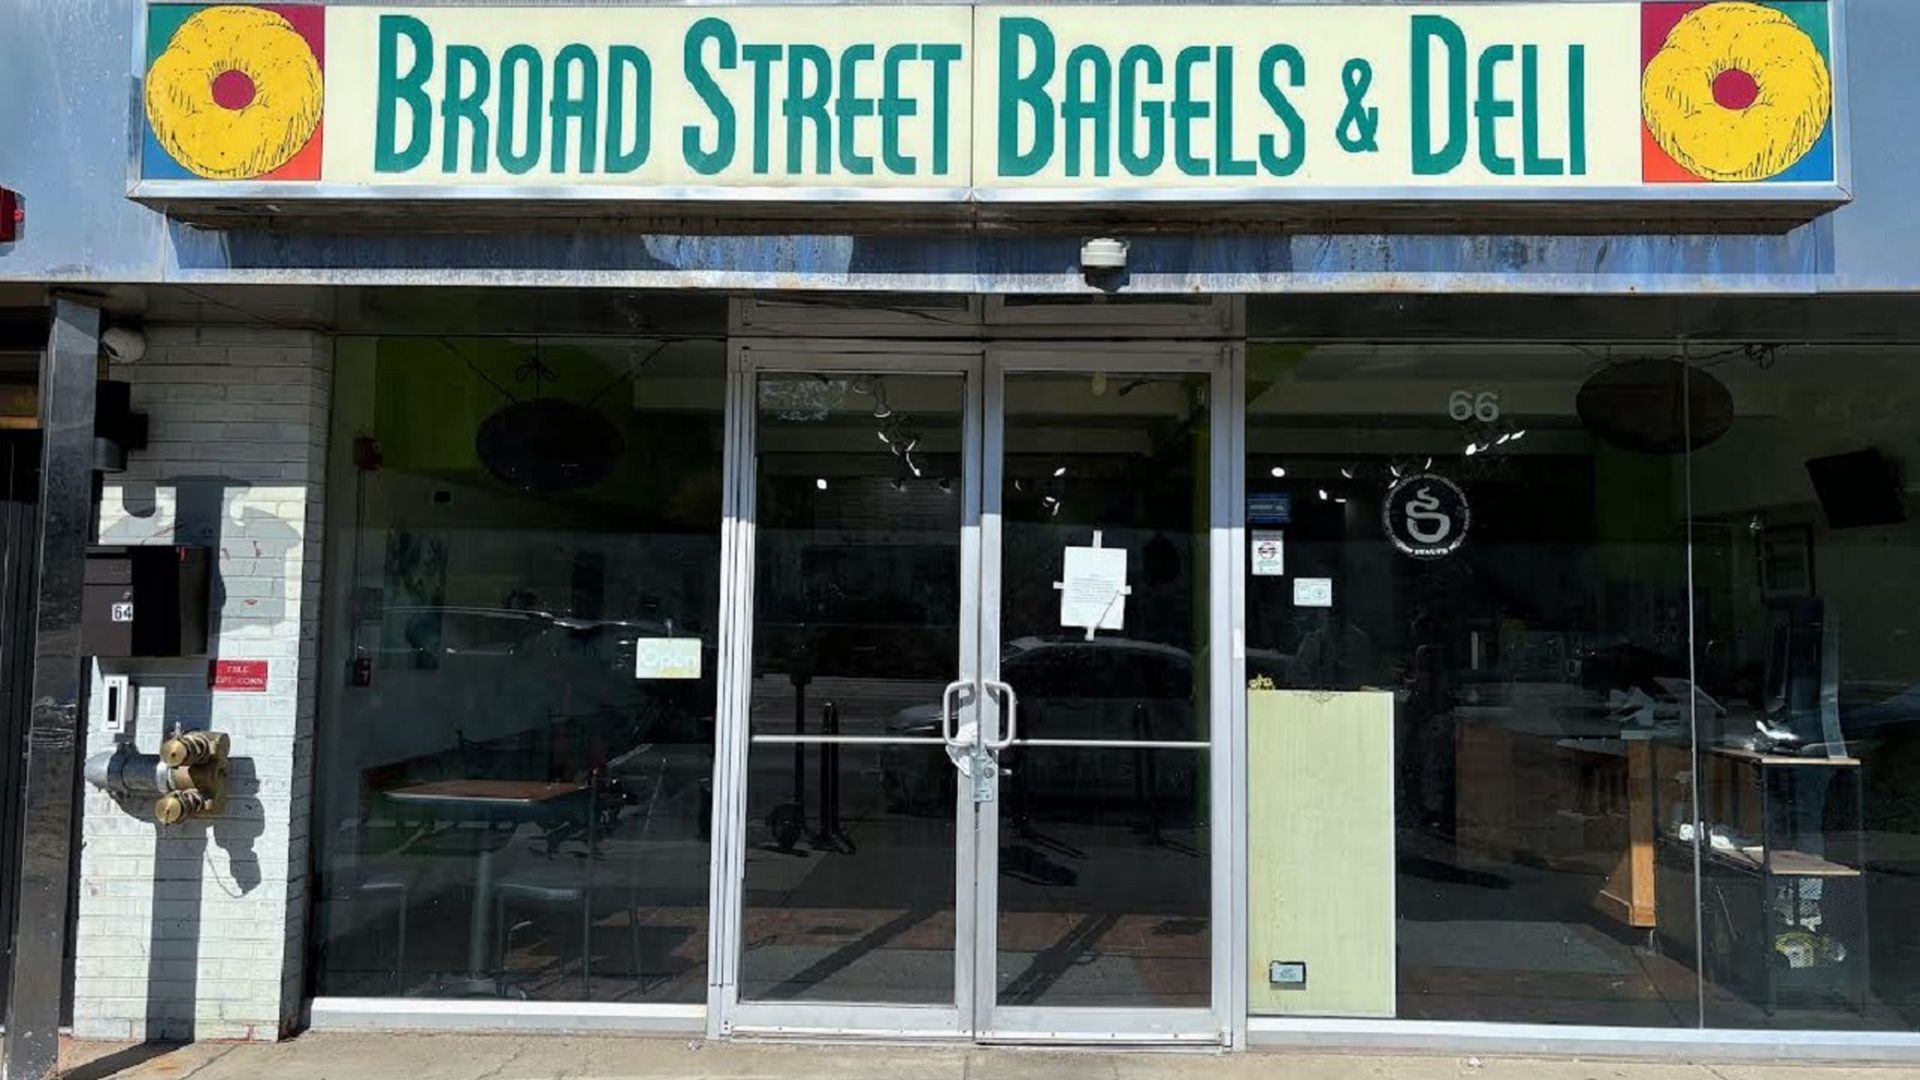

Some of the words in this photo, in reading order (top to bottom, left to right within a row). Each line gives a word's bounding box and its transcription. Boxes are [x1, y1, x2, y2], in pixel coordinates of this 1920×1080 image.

[373, 15, 653, 174] BROAD
[682, 16, 963, 177] STREET
[998, 16, 1306, 178] BAGELS
[1336, 58, 1380, 153] &
[1409, 14, 1587, 177] DELI
[1448, 390, 1499, 422] 66
[114, 604, 132, 620] 64
